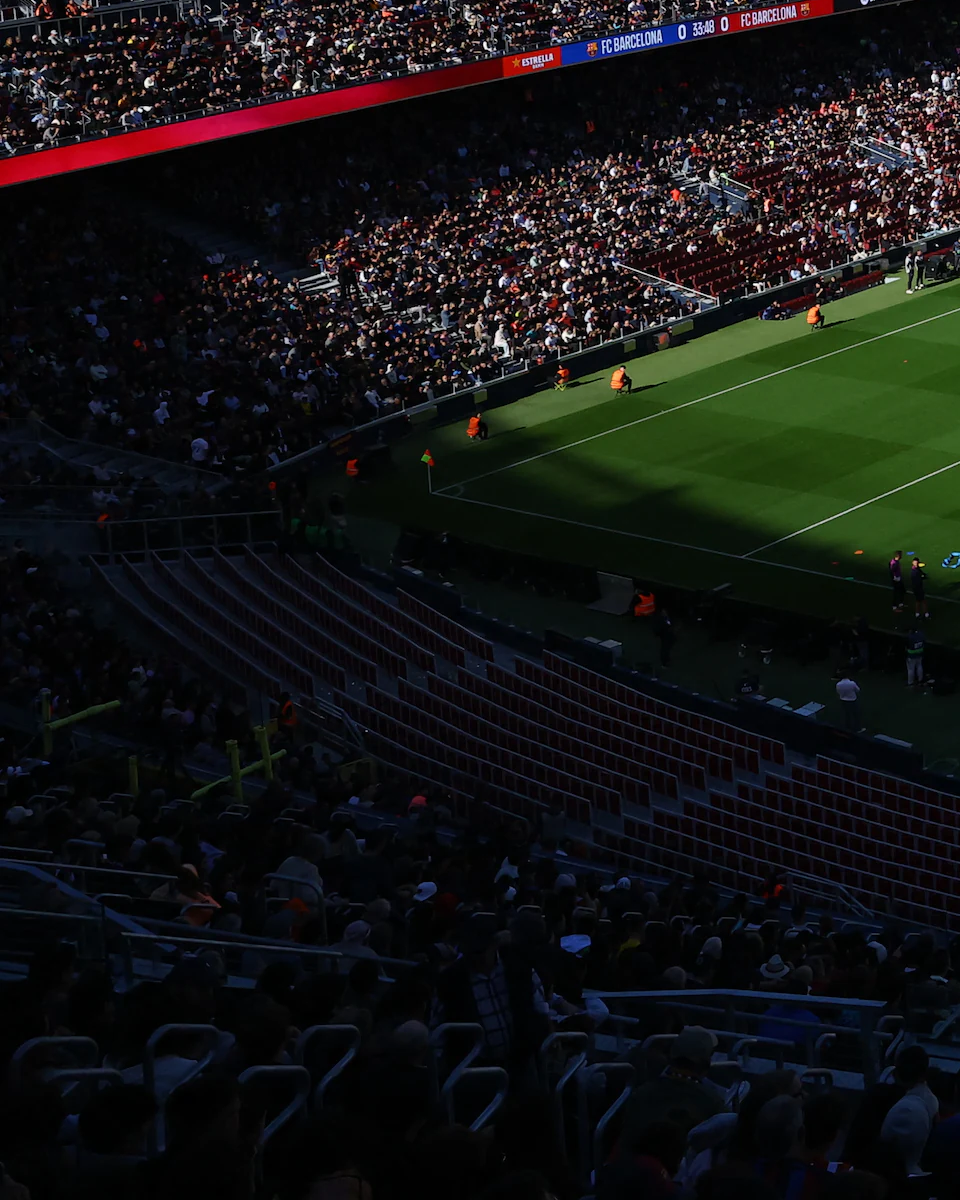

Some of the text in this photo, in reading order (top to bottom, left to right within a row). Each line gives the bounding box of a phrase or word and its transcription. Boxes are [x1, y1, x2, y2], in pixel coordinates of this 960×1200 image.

[601, 5, 797, 54] FC BARCELONA 0 33:48 0 FC BARCELONA
[522, 53, 554, 66] ESTRELLA
